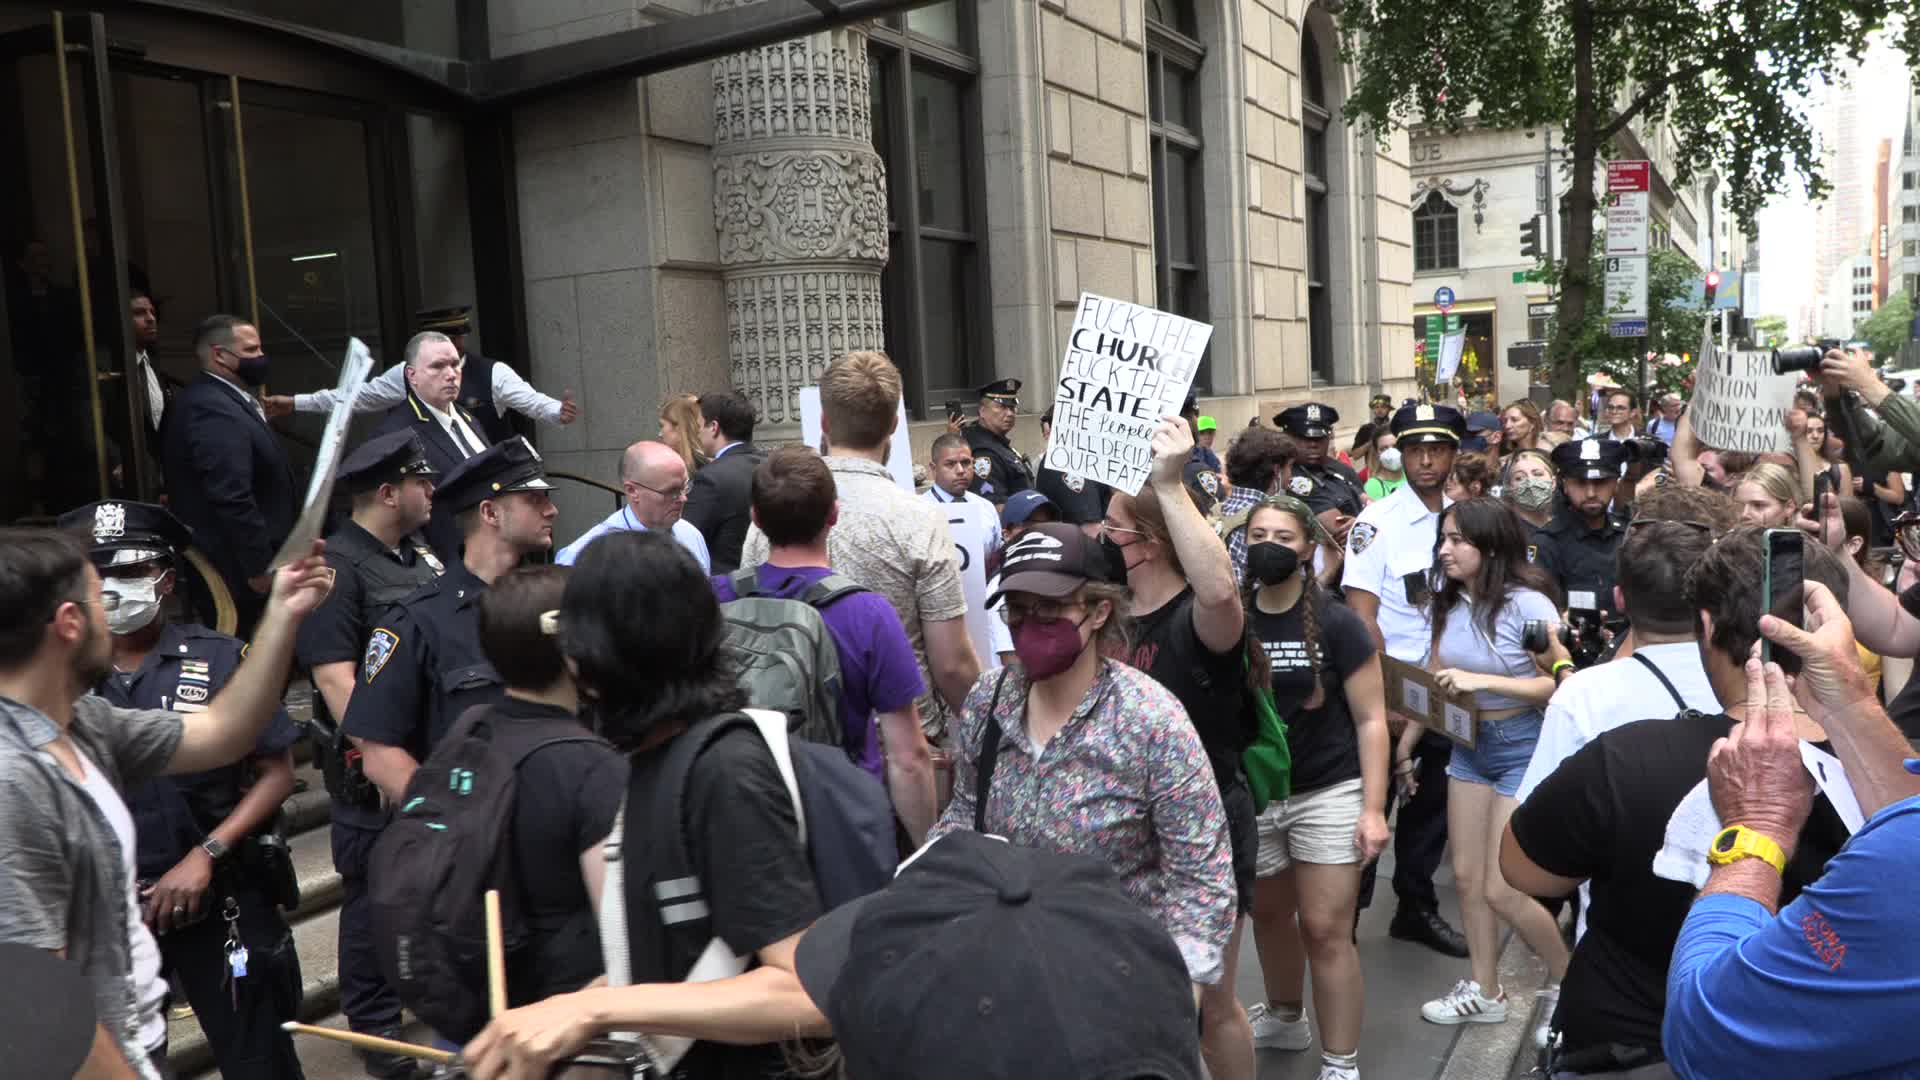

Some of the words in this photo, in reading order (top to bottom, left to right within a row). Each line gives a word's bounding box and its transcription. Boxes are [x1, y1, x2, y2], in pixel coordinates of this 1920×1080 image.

[1609, 259, 1617, 271] 6
[1081, 296, 1143, 338] FUCK
[1149, 312, 1204, 353] THE
[1072, 328, 1197, 383] CHURCH
[1066, 350, 1123, 387] FUCK
[1129, 367, 1182, 404] THE
[1057, 400, 1095, 431] THE
[1706, 400, 1747, 426] ONLY
[1055, 427, 1097, 454] WILL
[1050, 447, 1101, 480] OUR
